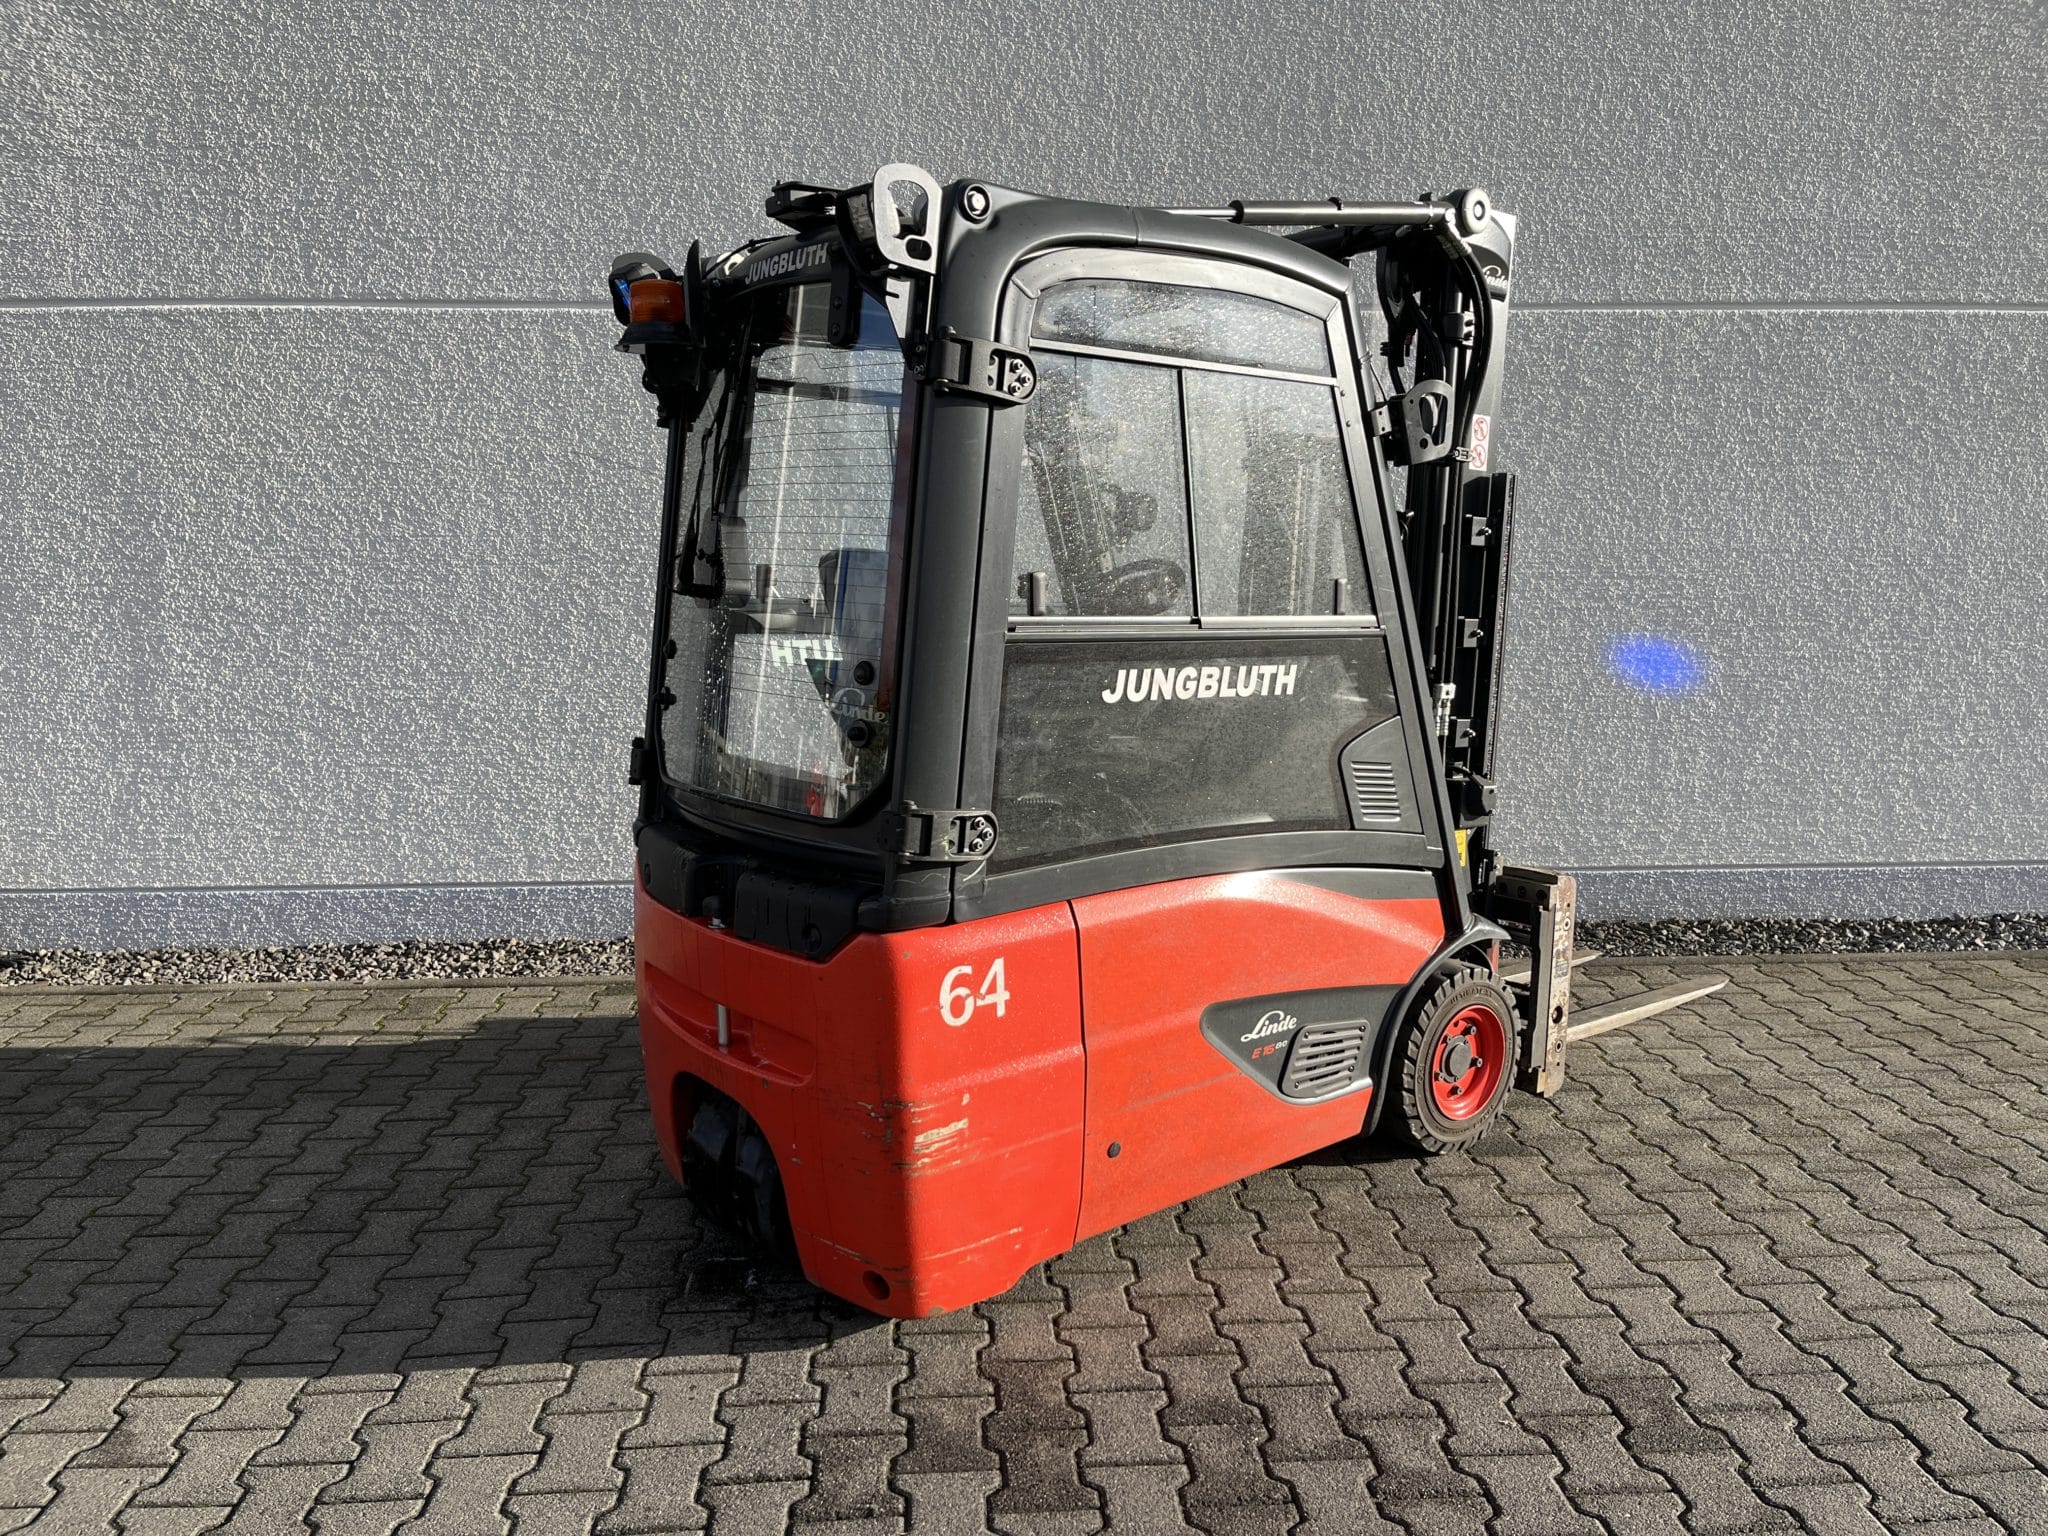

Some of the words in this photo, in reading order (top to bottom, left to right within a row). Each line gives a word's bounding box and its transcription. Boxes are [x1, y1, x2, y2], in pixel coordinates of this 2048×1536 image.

[744, 242, 829, 285] JUNGBLUTH
[1101, 664, 1298, 704] JUNGBLUTH
[938, 956, 1011, 1027] 64
[1240, 1010, 1298, 1042] Linde
